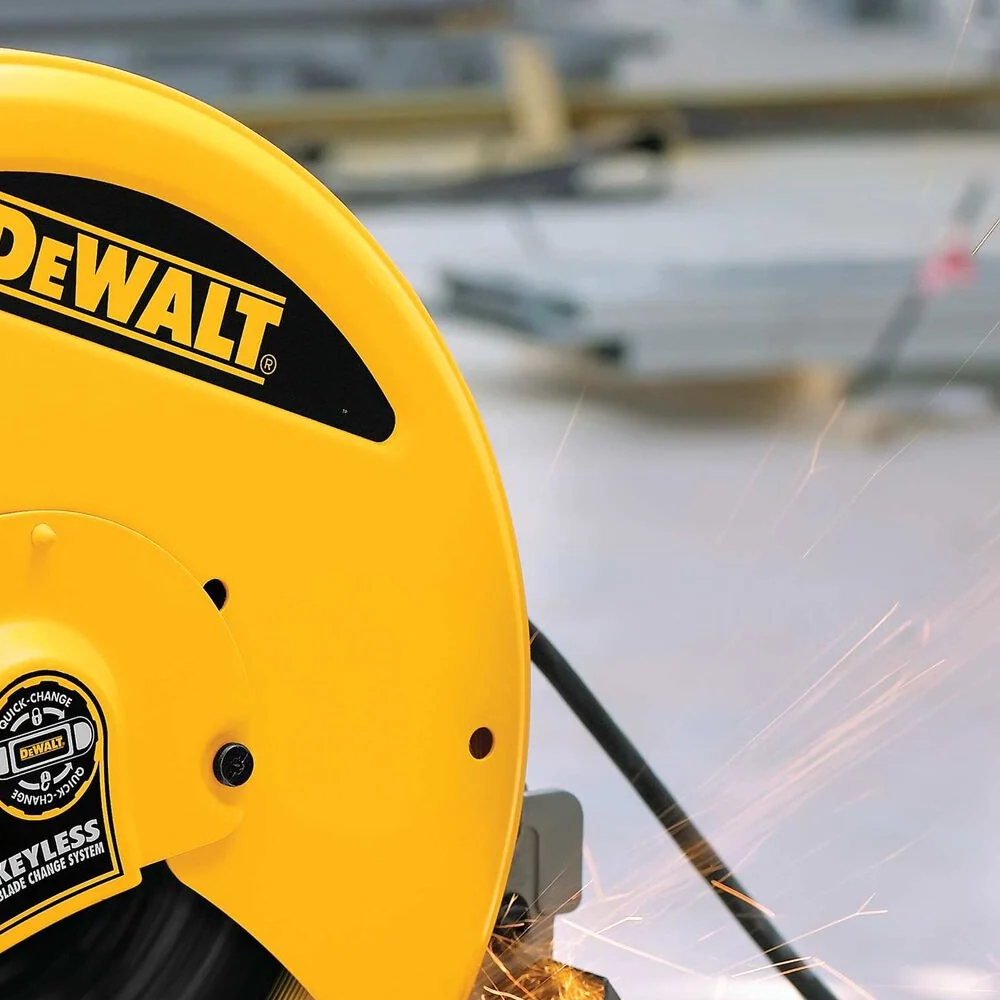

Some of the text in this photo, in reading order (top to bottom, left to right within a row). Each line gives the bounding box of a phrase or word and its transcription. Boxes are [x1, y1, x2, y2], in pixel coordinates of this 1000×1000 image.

[11, 766, 85, 805] QUICK-CHANGE
[27, 857, 67, 884] CHANGE
[67, 841, 105, 866] SYSTEM
